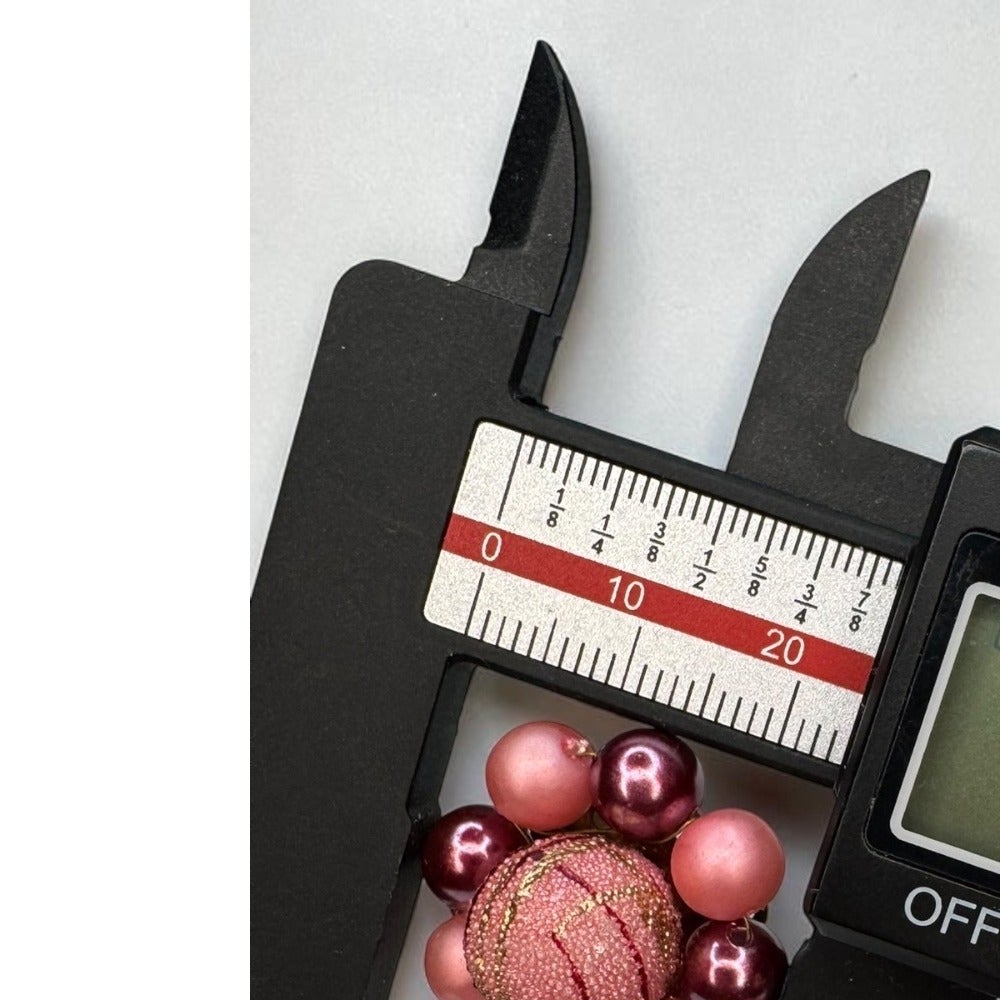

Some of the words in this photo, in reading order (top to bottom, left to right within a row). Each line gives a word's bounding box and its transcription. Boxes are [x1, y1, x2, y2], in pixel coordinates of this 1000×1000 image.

[481, 531, 503, 562] 0
[608, 575, 646, 611] 10
[760, 628, 806, 666] 20
